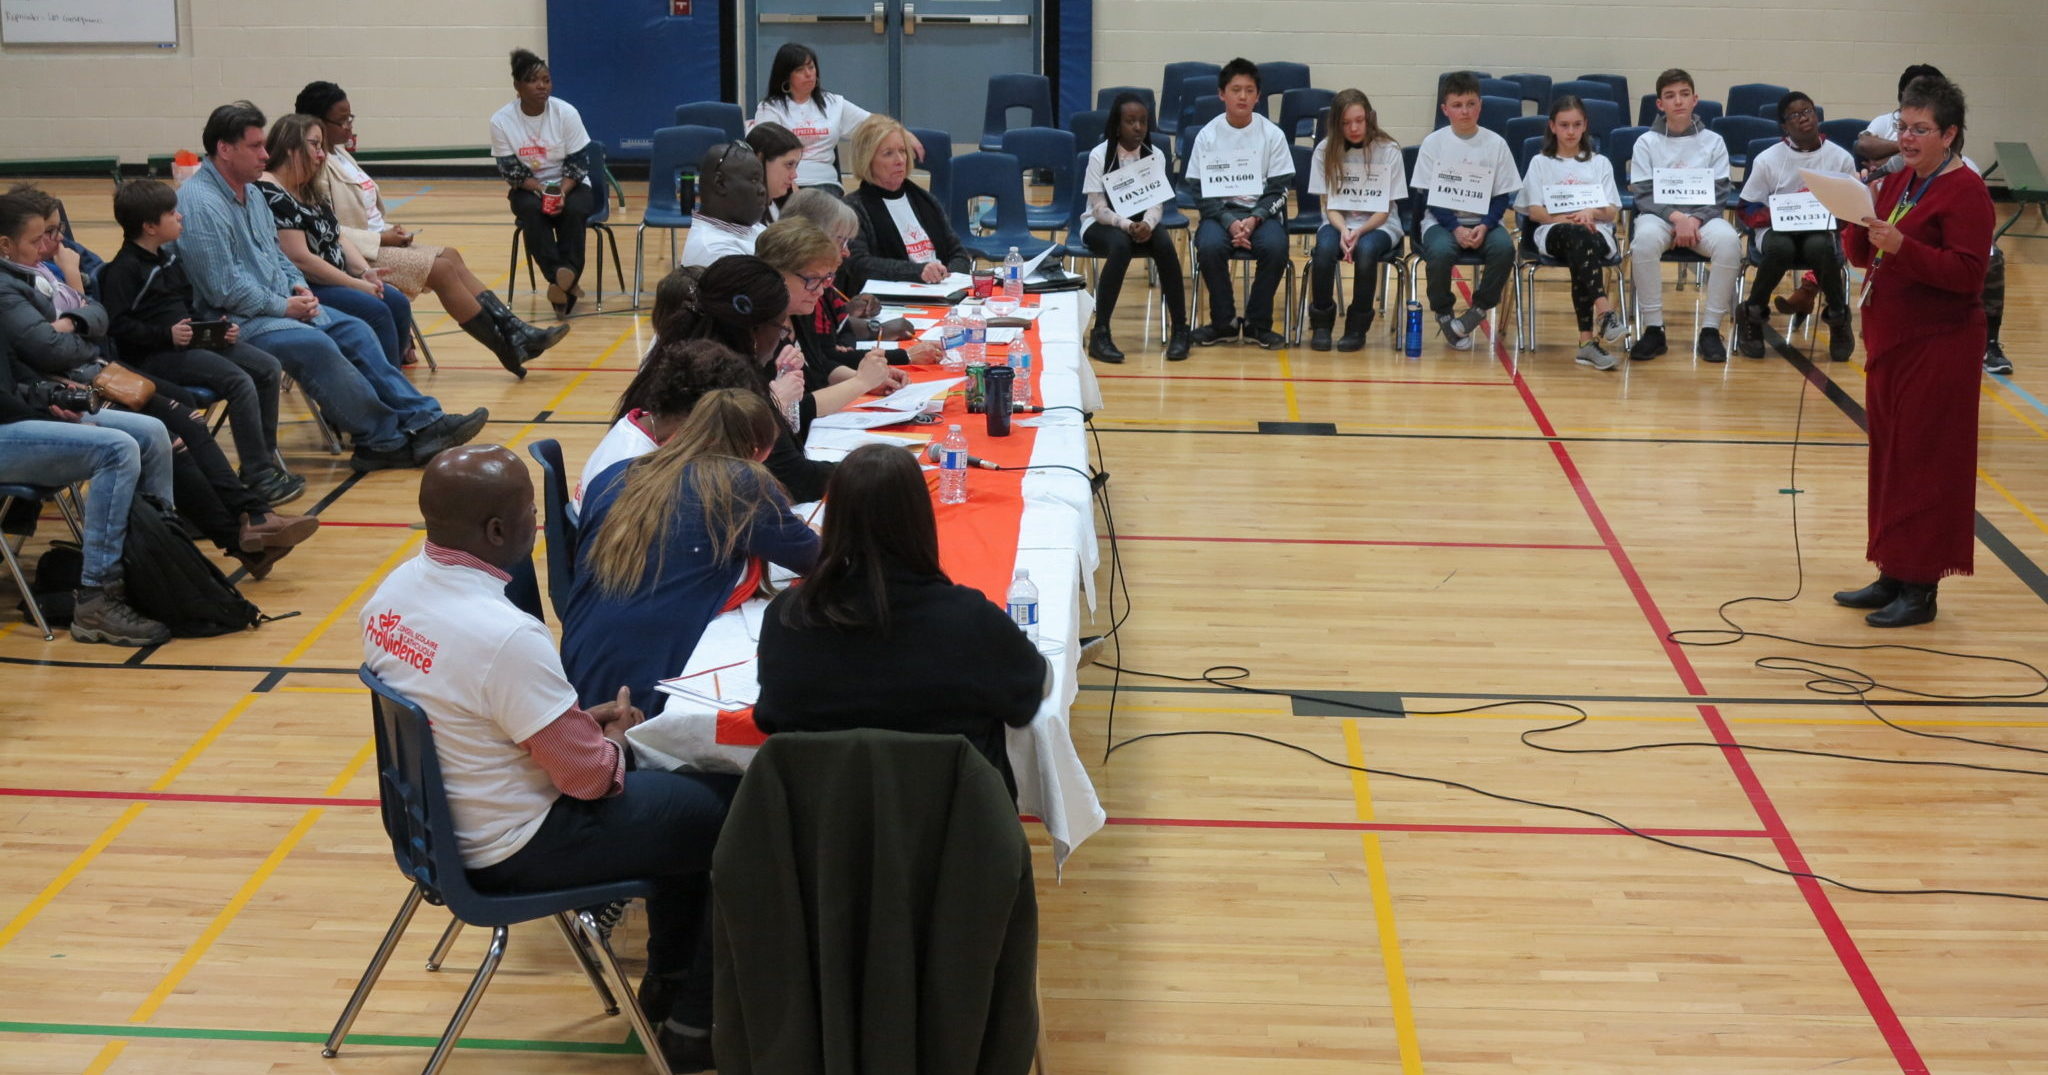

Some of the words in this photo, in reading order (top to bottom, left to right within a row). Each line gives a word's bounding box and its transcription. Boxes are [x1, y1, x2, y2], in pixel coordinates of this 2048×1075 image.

[1208, 173, 1255, 184] LON1600
[1119, 179, 1162, 204] LON2162
[1335, 187, 1383, 197] LON1502
[1436, 184, 1484, 200] LON1338
[1660, 188, 1708, 196] LON1336
[364, 614, 433, 675] Providence
